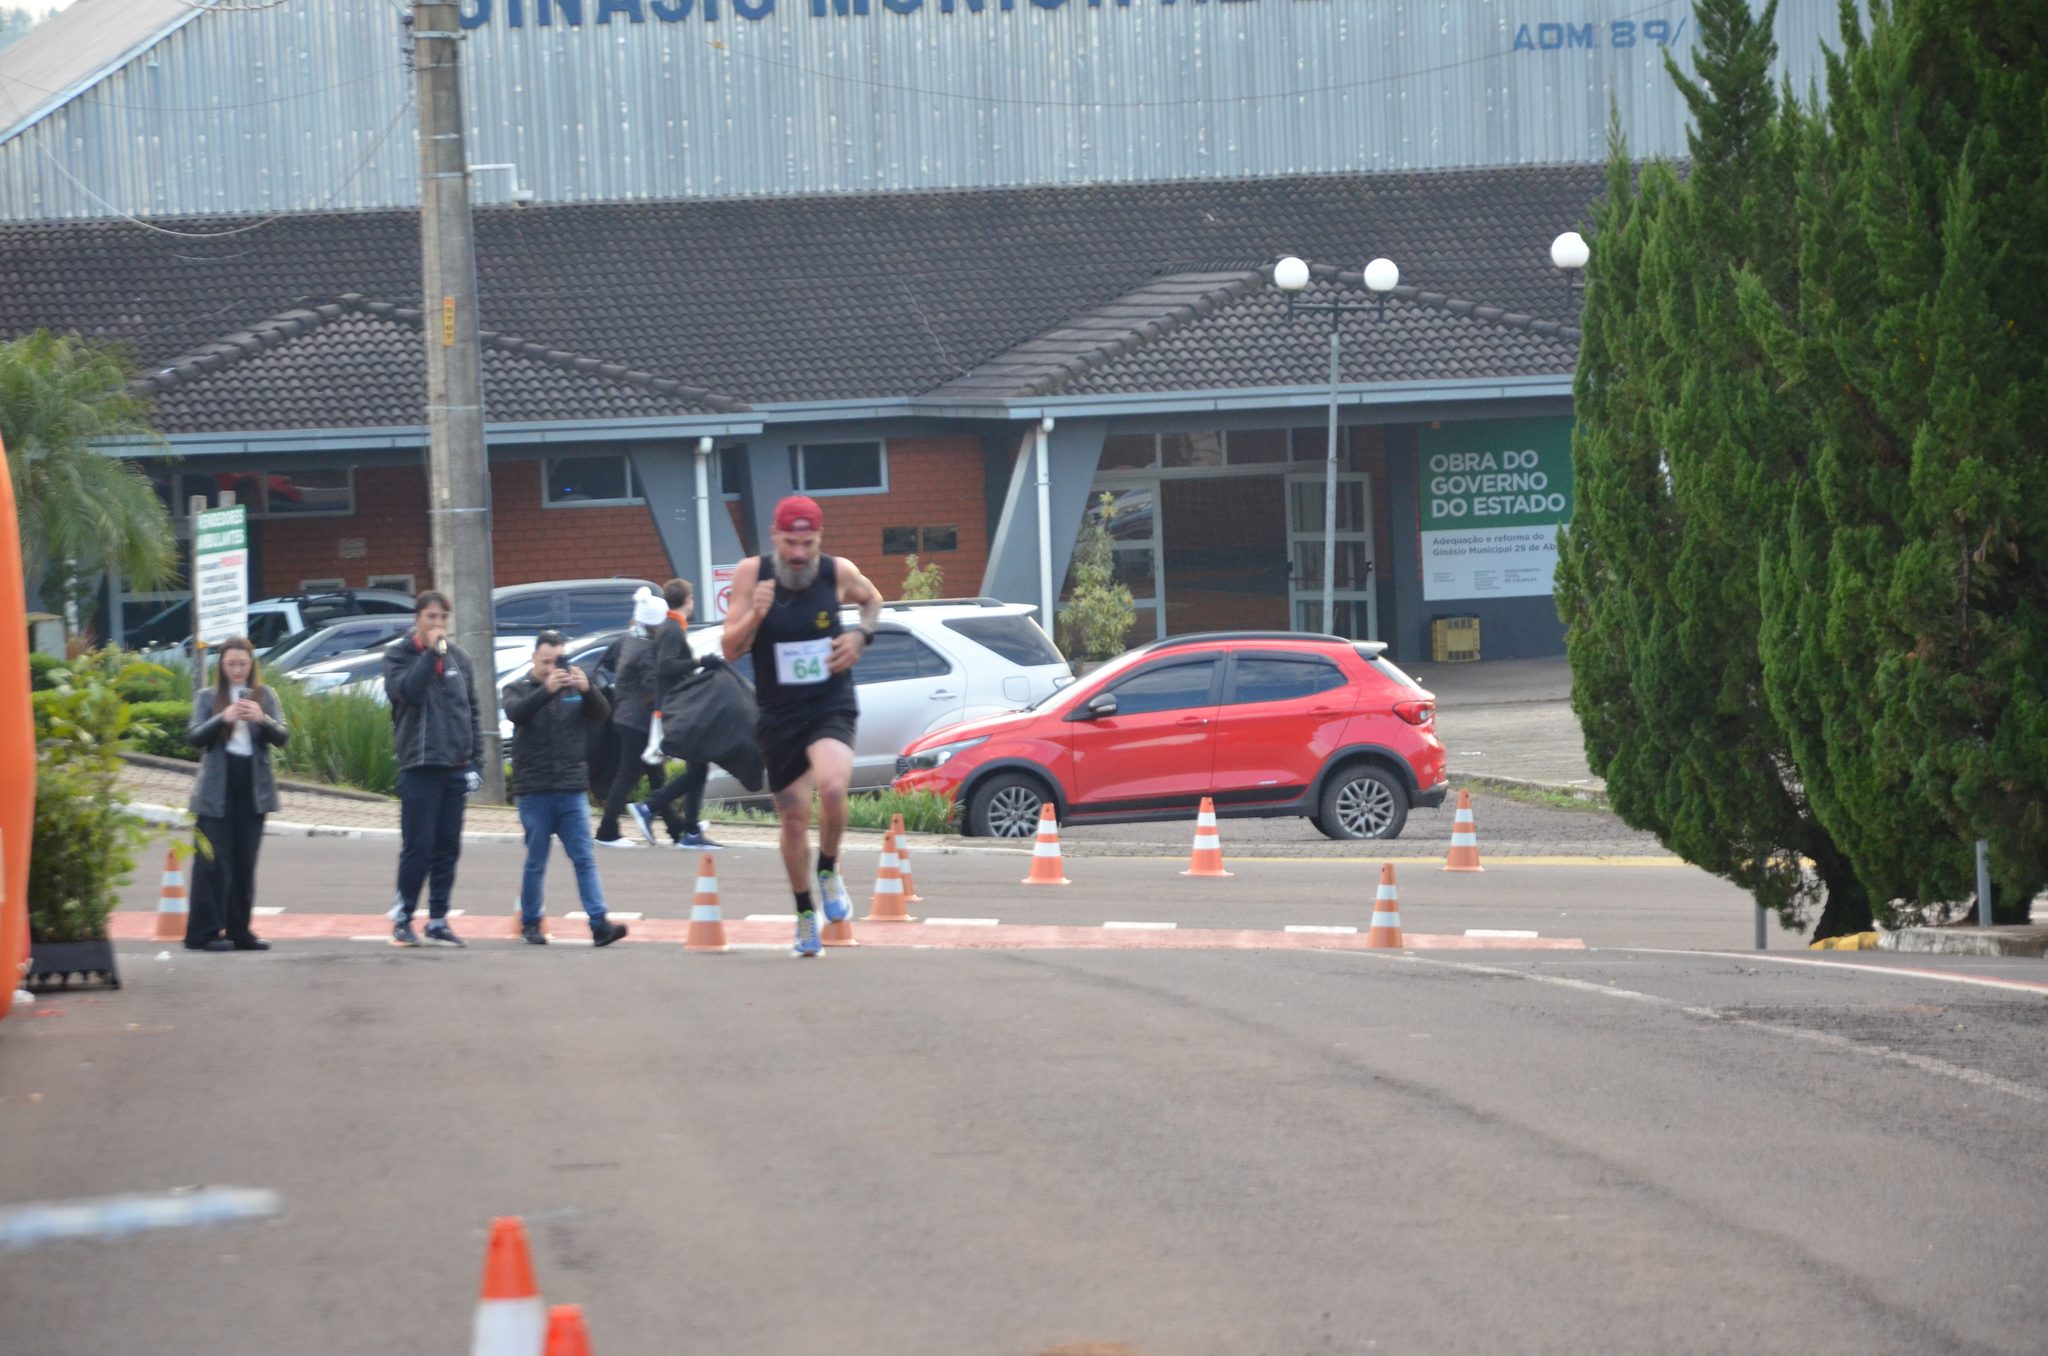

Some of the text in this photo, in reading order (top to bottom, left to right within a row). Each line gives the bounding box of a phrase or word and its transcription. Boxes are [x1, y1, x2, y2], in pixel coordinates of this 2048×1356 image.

[1430, 449, 1539, 473] OBRA DO
[1431, 471, 1548, 495] GOVERNO
[1432, 493, 1566, 518] DO ESTADO
[1432, 535, 1483, 546] Adequação
[1494, 533, 1530, 542] reforma
[1532, 532, 1545, 541] do
[1432, 542, 1558, 556] Ginásio Municipal 29 de Ab
[793, 656, 821, 680] 64
